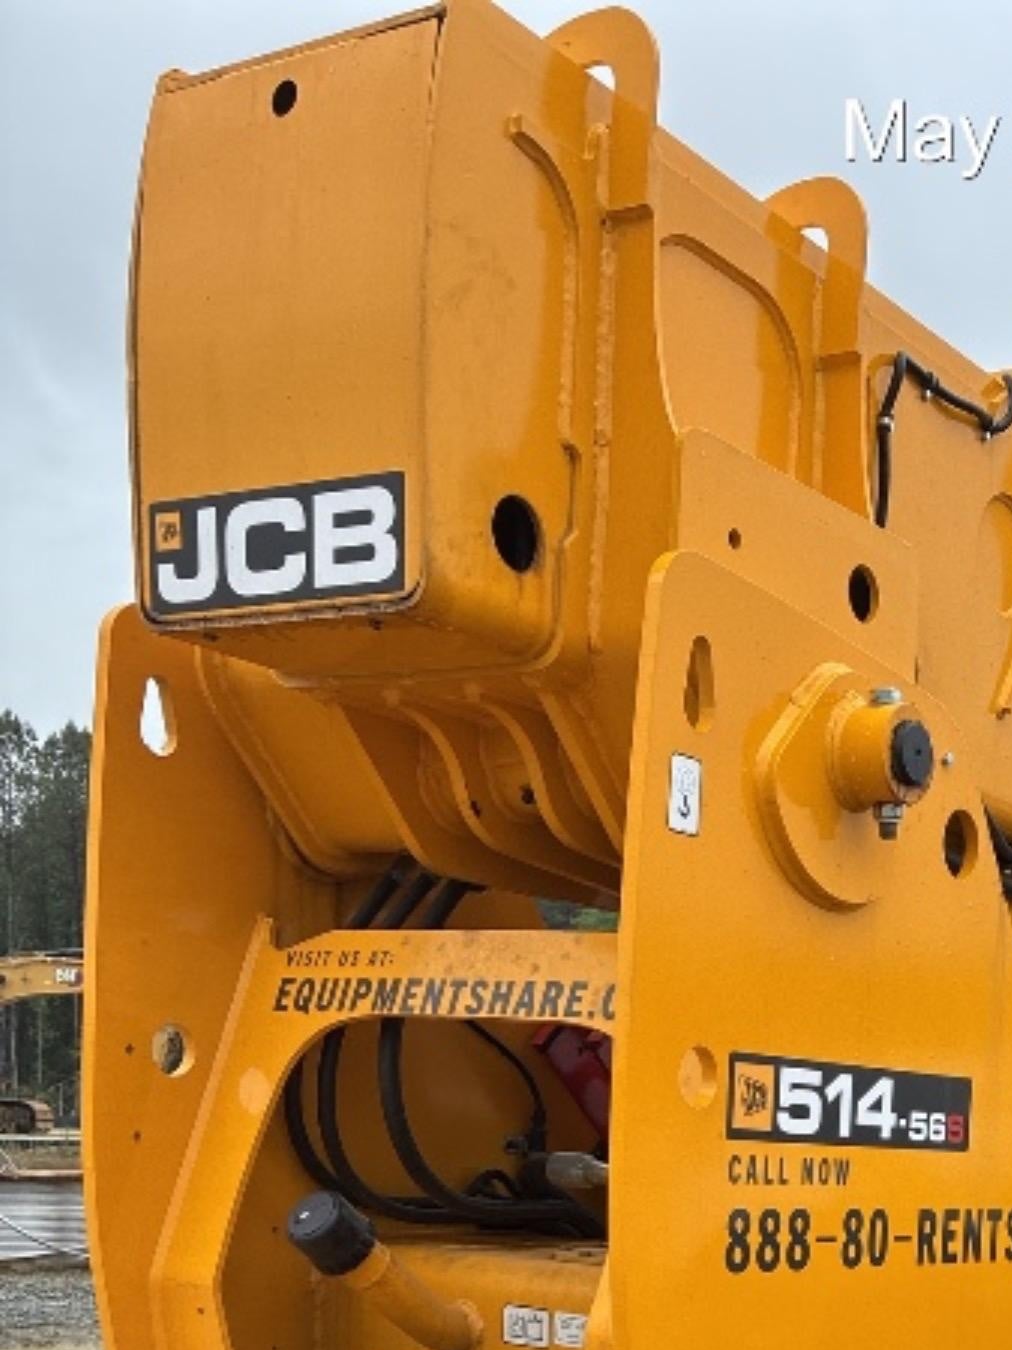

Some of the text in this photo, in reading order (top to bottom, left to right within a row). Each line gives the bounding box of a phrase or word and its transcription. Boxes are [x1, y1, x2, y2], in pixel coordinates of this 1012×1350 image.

[156, 485, 399, 604] JCB
[286, 949, 333, 967] VISIT
[728, 1154, 850, 1186] CALL NOW
